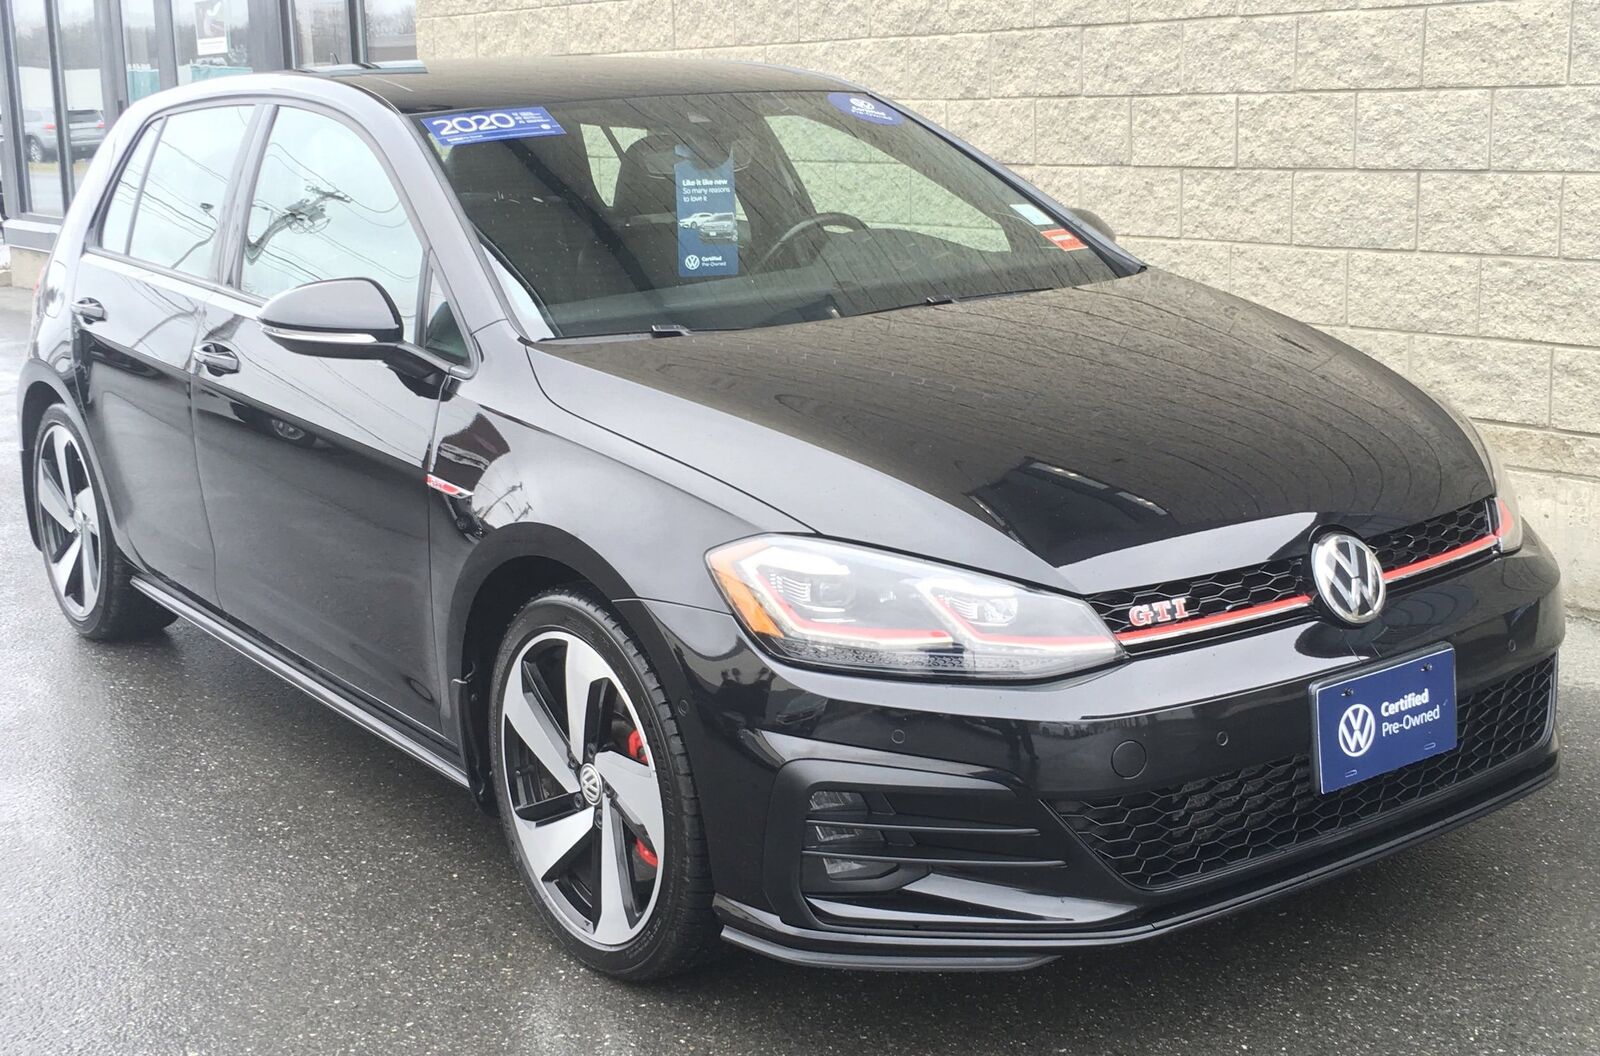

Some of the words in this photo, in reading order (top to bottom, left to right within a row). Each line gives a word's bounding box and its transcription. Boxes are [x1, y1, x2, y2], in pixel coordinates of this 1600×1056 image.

[432, 112, 516, 136] 2020
[683, 187, 691, 195] So
[1129, 597, 1189, 627] GTI
[1381, 688, 1430, 718] Certified
[1382, 704, 1441, 737] Pre-Owned
